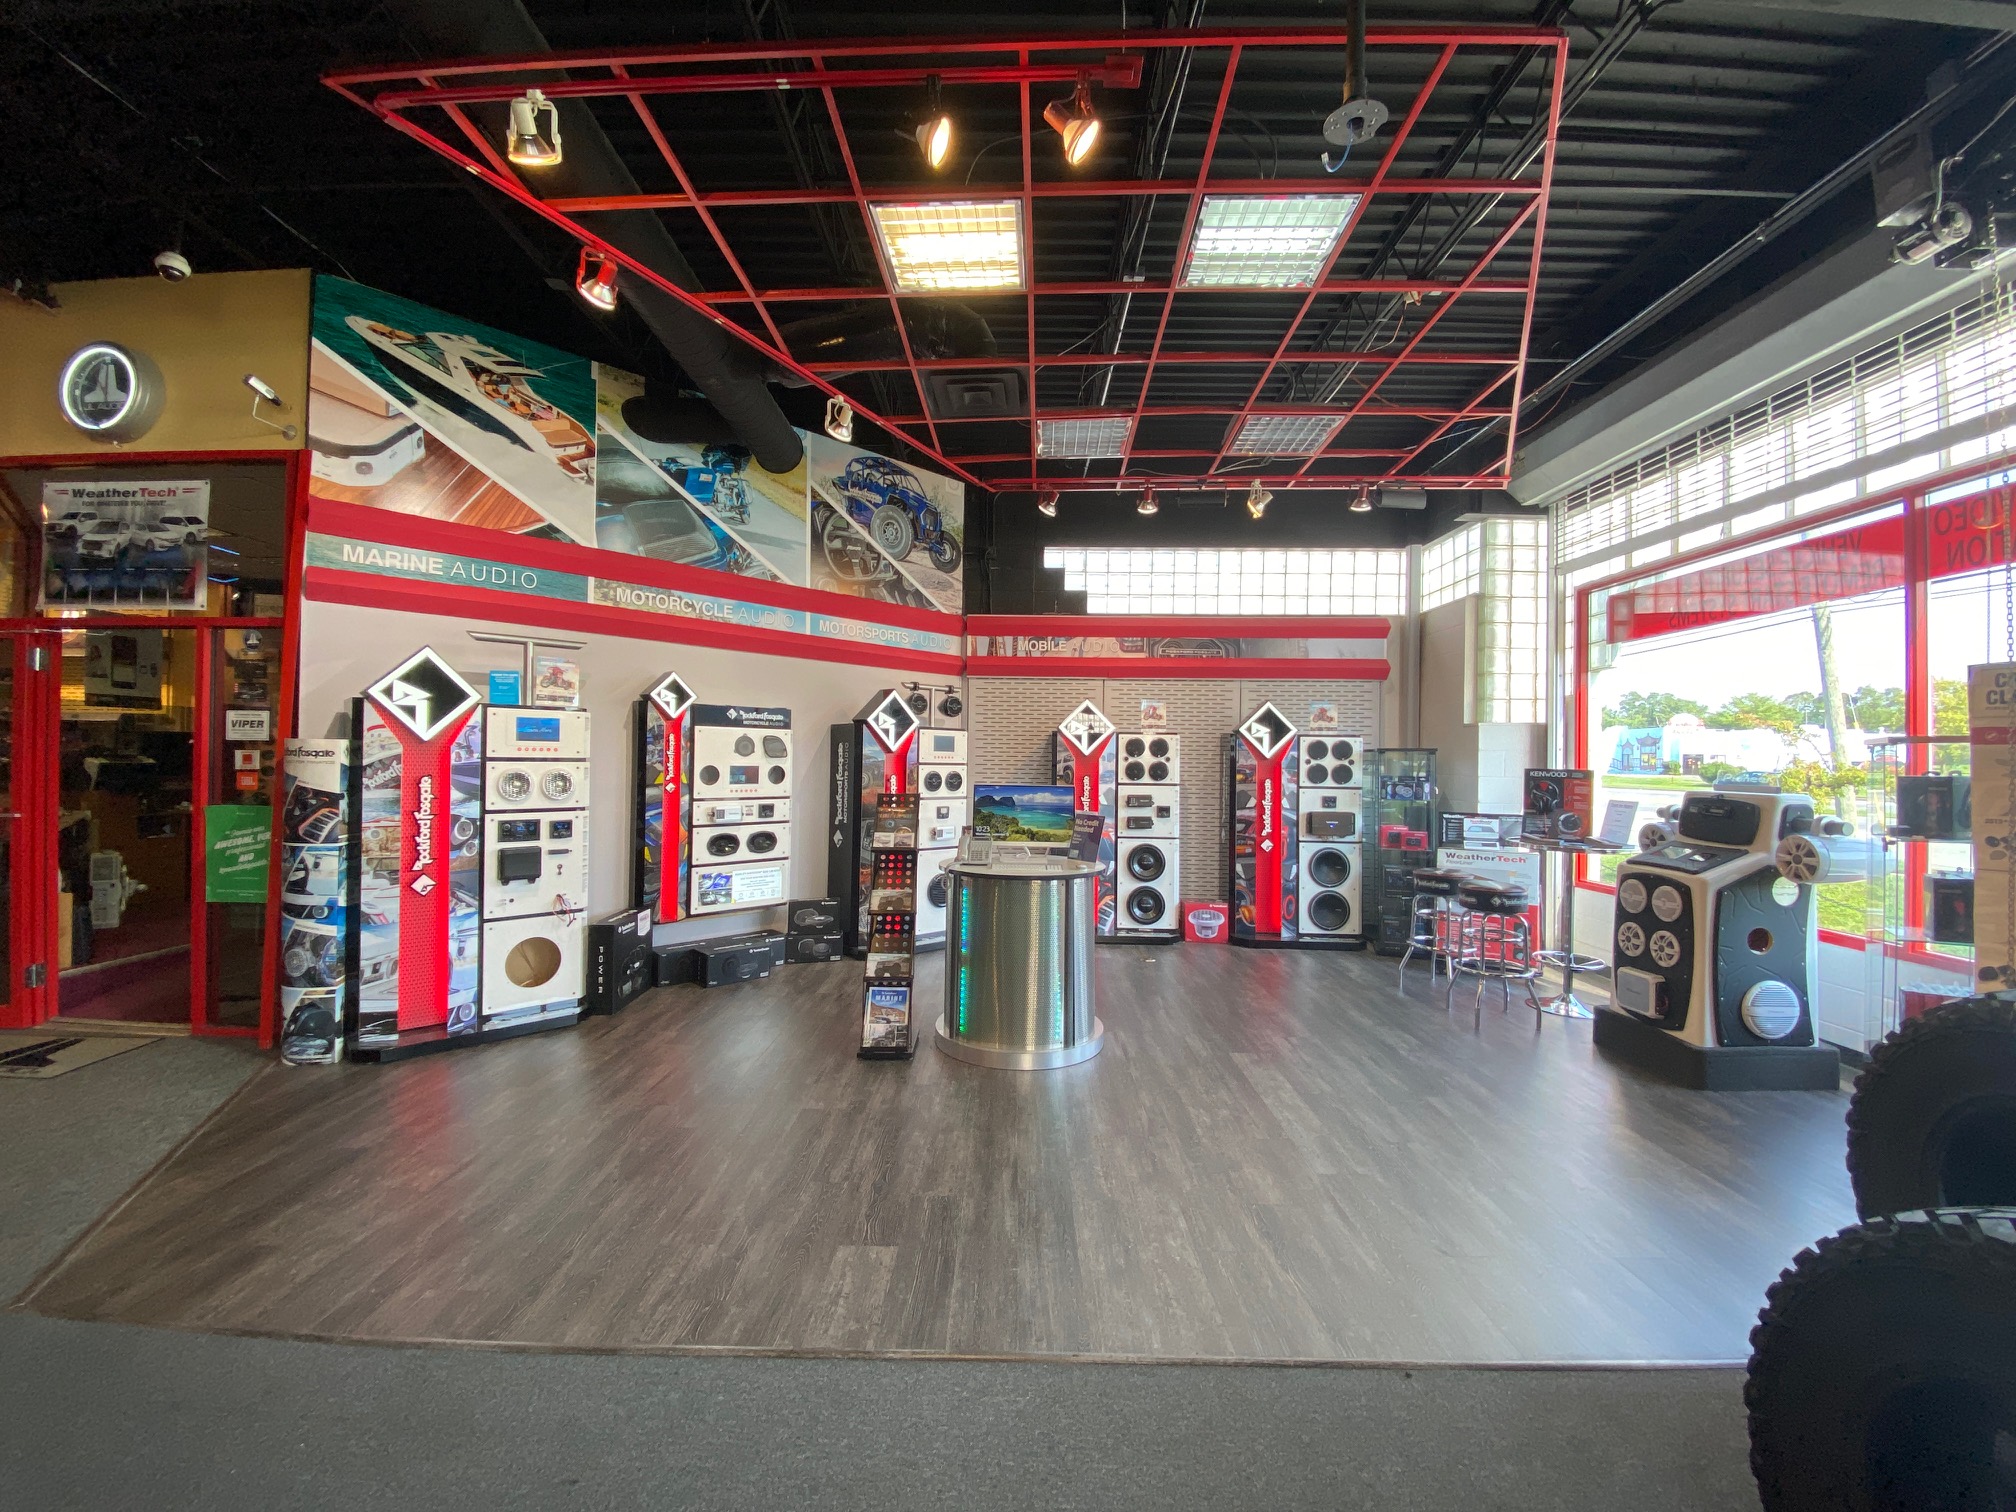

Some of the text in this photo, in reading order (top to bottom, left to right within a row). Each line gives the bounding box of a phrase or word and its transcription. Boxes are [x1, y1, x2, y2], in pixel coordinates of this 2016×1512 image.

[71, 487, 177, 499] WeatherTech
[342, 544, 538, 589] MARINE AUDIO
[616, 587, 795, 628] MOTORCYCLE AUDIO
[819, 620, 952, 649] MOTORSPORTS AUDIO
[1018, 640, 1120, 652] MOBILE AUDIO
[231, 719, 265, 729] VIPER
[976, 825, 990, 833] 10:23
[1445, 852, 1526, 864] WeatherTech
